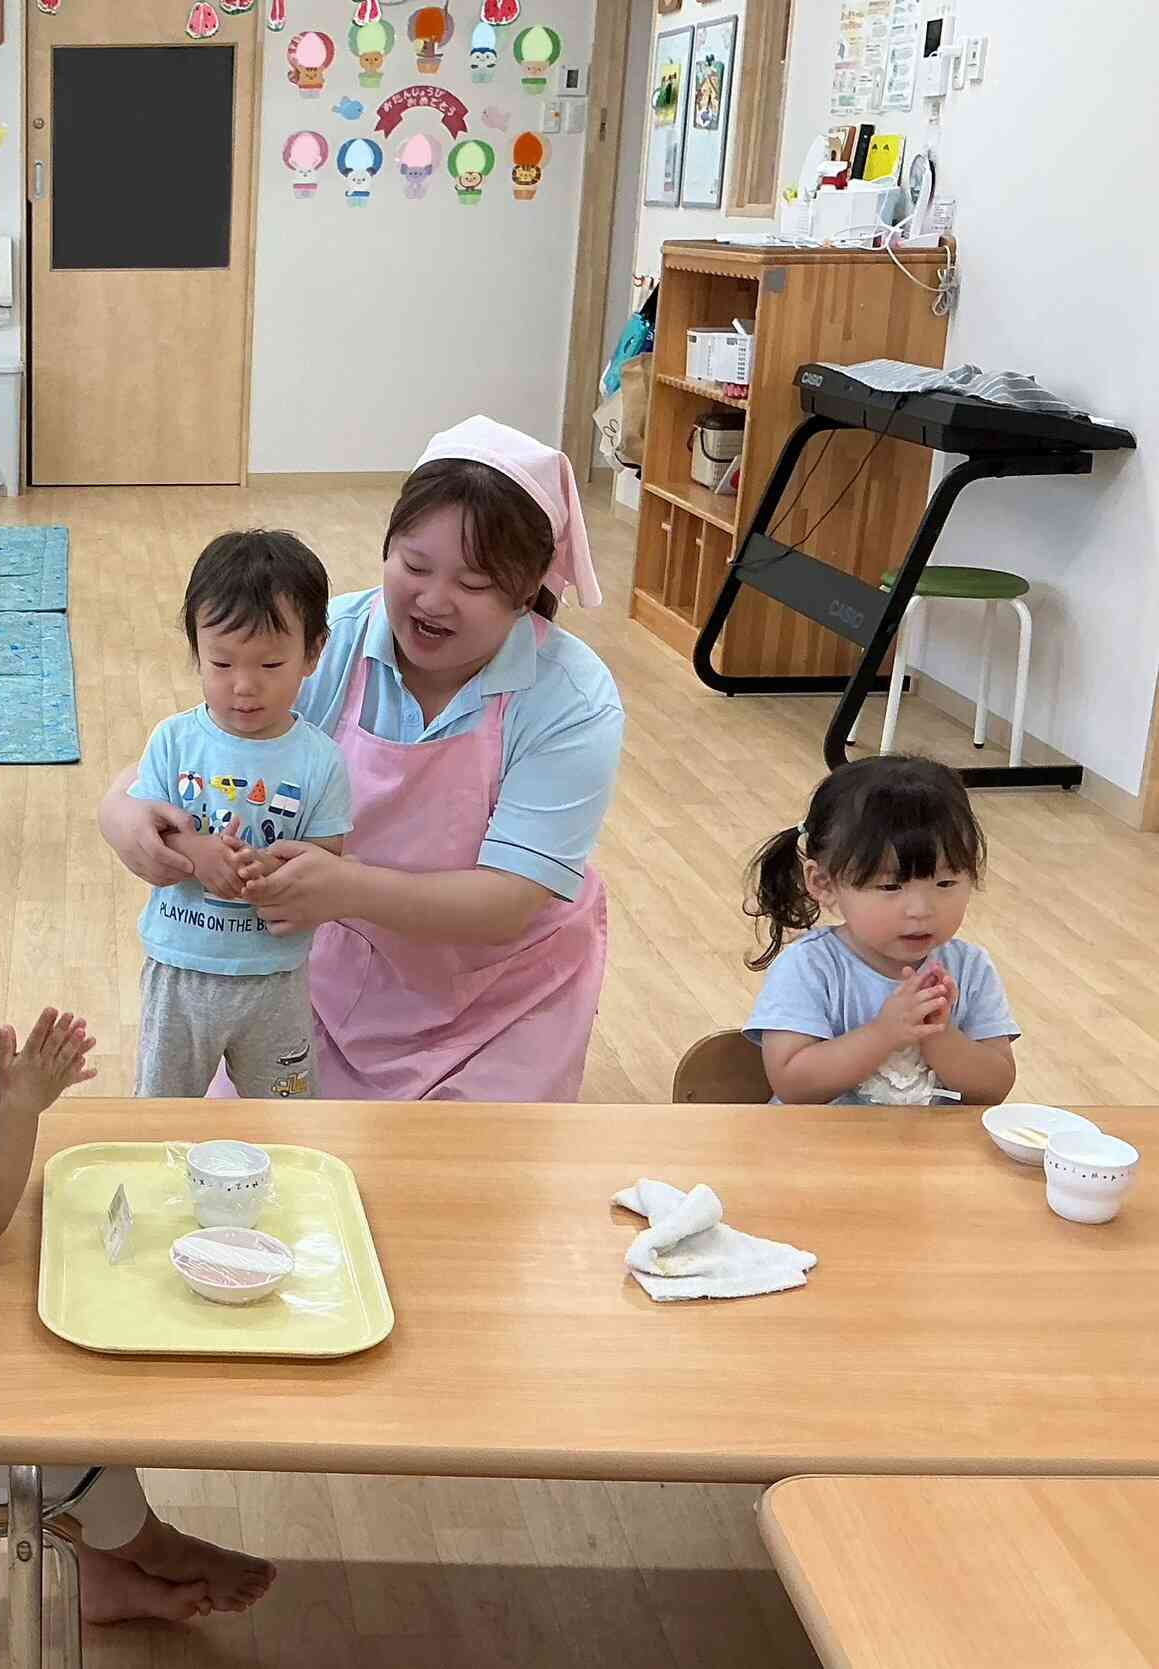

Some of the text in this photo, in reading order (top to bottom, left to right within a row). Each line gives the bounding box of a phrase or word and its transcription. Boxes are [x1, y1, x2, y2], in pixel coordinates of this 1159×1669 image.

[801, 371, 824, 387] CASIO
[829, 599, 865, 630] CASIO
[160, 901, 206, 928] PLAYING
[207, 915, 225, 932] ON
[228, 918, 253, 932] THE
